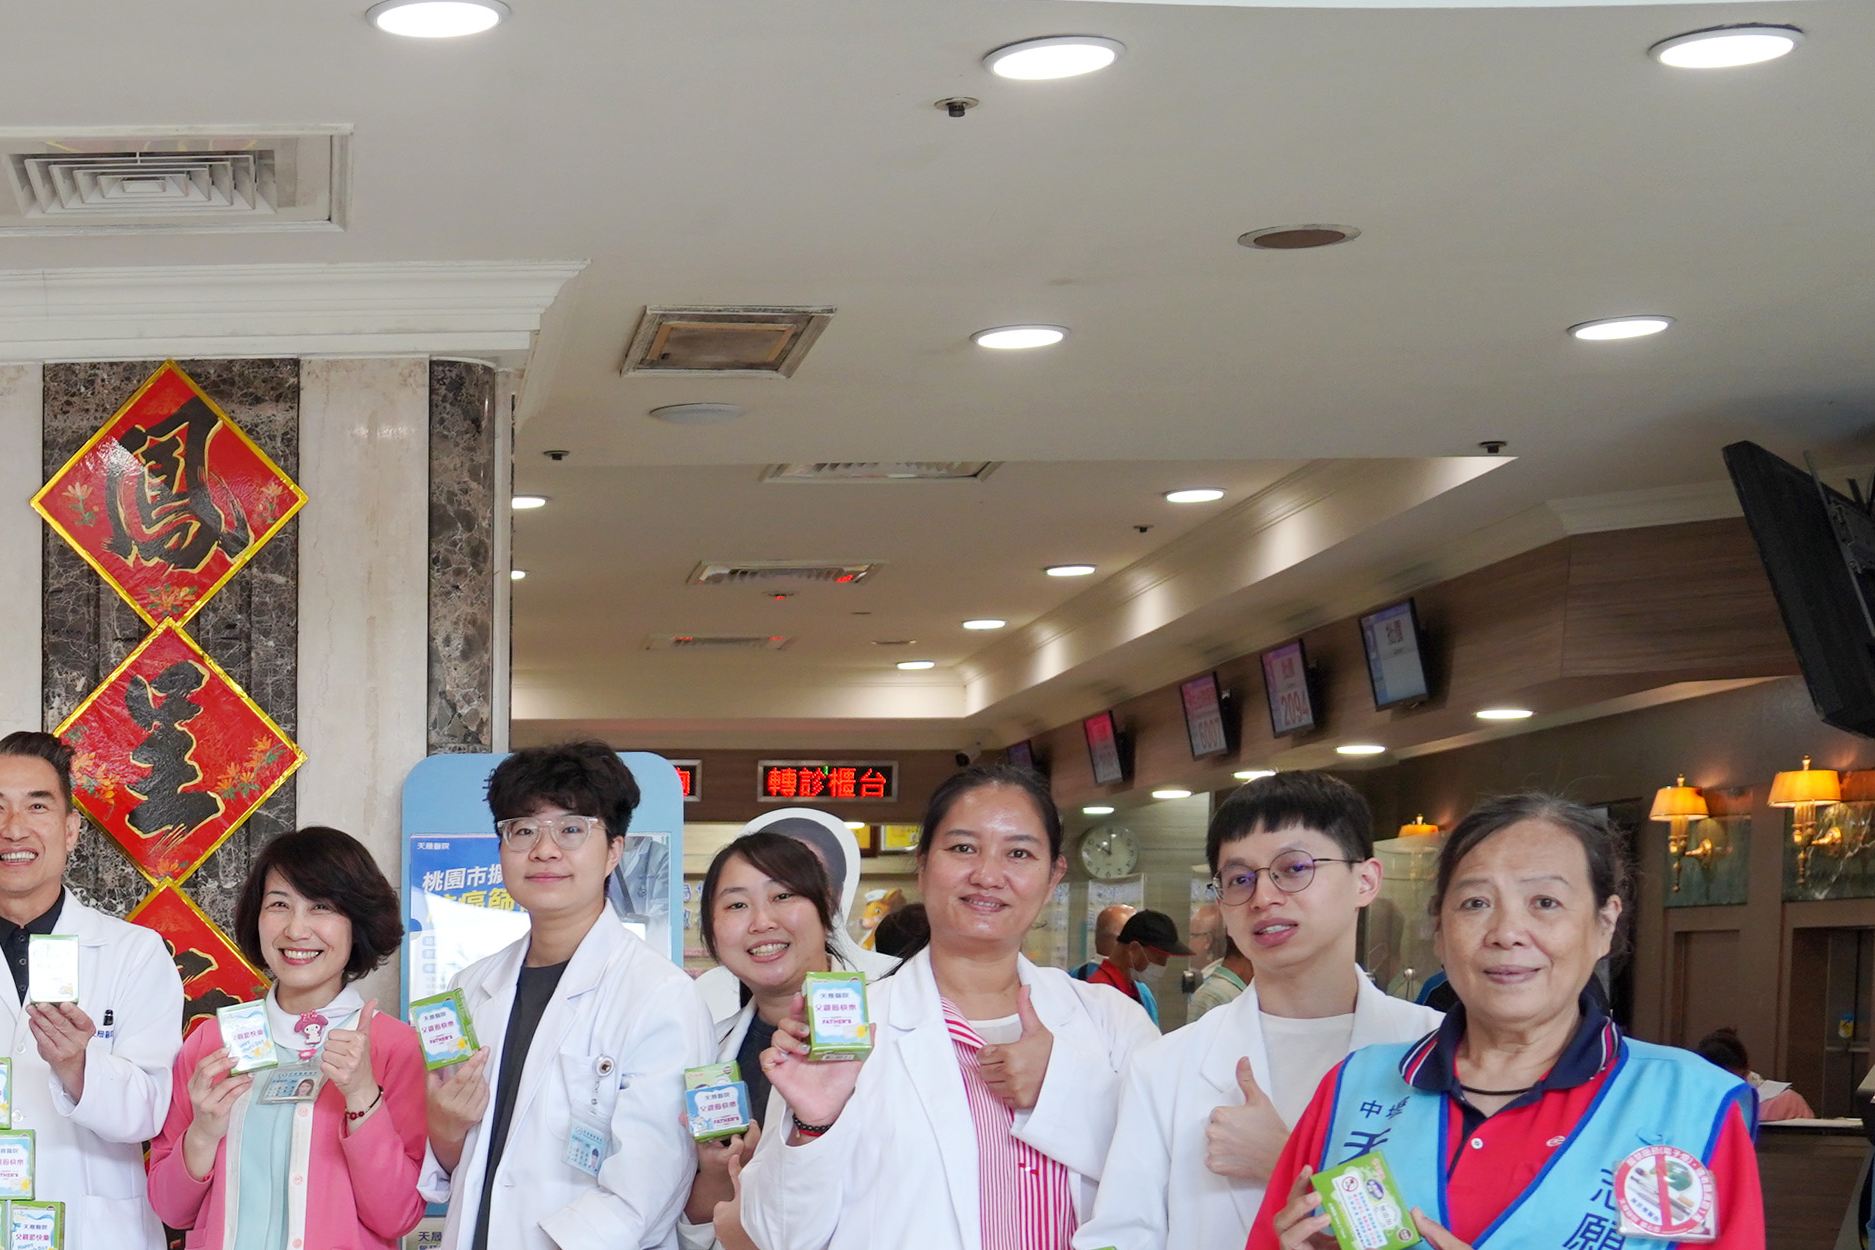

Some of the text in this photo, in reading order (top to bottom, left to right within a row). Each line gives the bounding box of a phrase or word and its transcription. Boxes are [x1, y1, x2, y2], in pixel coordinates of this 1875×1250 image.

[767, 767, 887, 798] 轉診櫃台
[1360, 1096, 1410, 1119] 中壢
